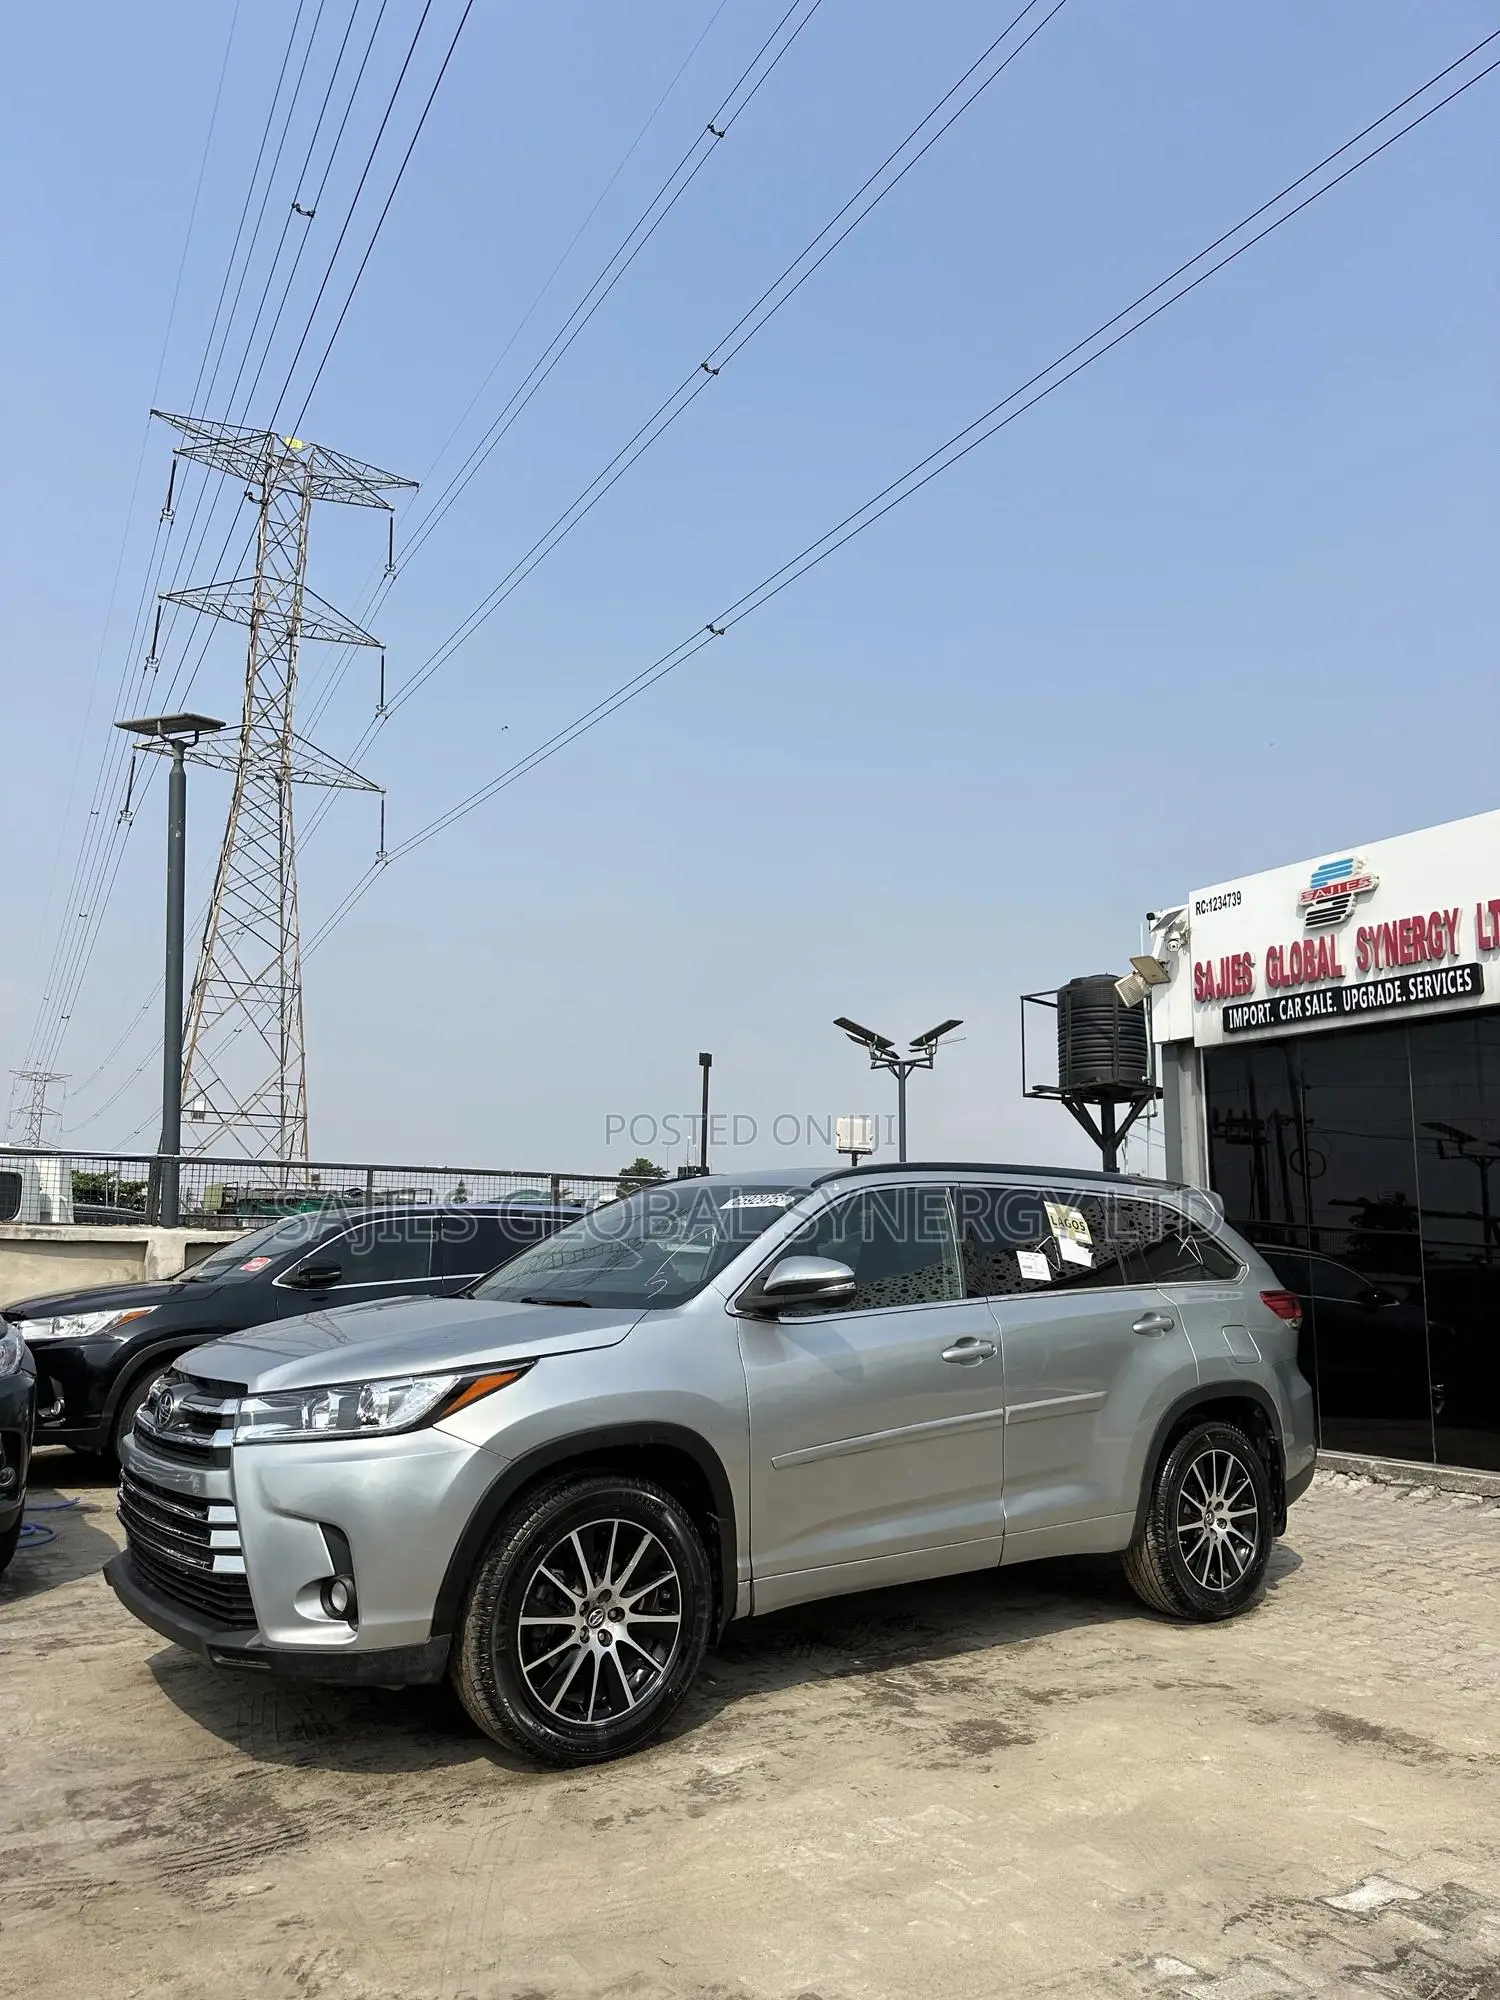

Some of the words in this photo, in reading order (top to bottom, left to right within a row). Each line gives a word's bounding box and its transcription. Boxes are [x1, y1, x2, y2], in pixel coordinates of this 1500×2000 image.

[1300, 876, 1373, 902] SAJIES
[1195, 890, 1242, 916] RC:1234739
[1194, 951, 1255, 1002] SAJIES
[1265, 933, 1346, 989] GLOBAL
[1356, 907, 1462, 973] SYNERGY
[1228, 1003, 1275, 1030] IMPORT.
[1279, 997, 1304, 1022] CAR
[1305, 991, 1337, 1017] SALE.
[1342, 980, 1406, 1012] UPGRADE.
[1408, 968, 1472, 1001] SERVICES
[1050, 1215, 1086, 1232] LAGOS
